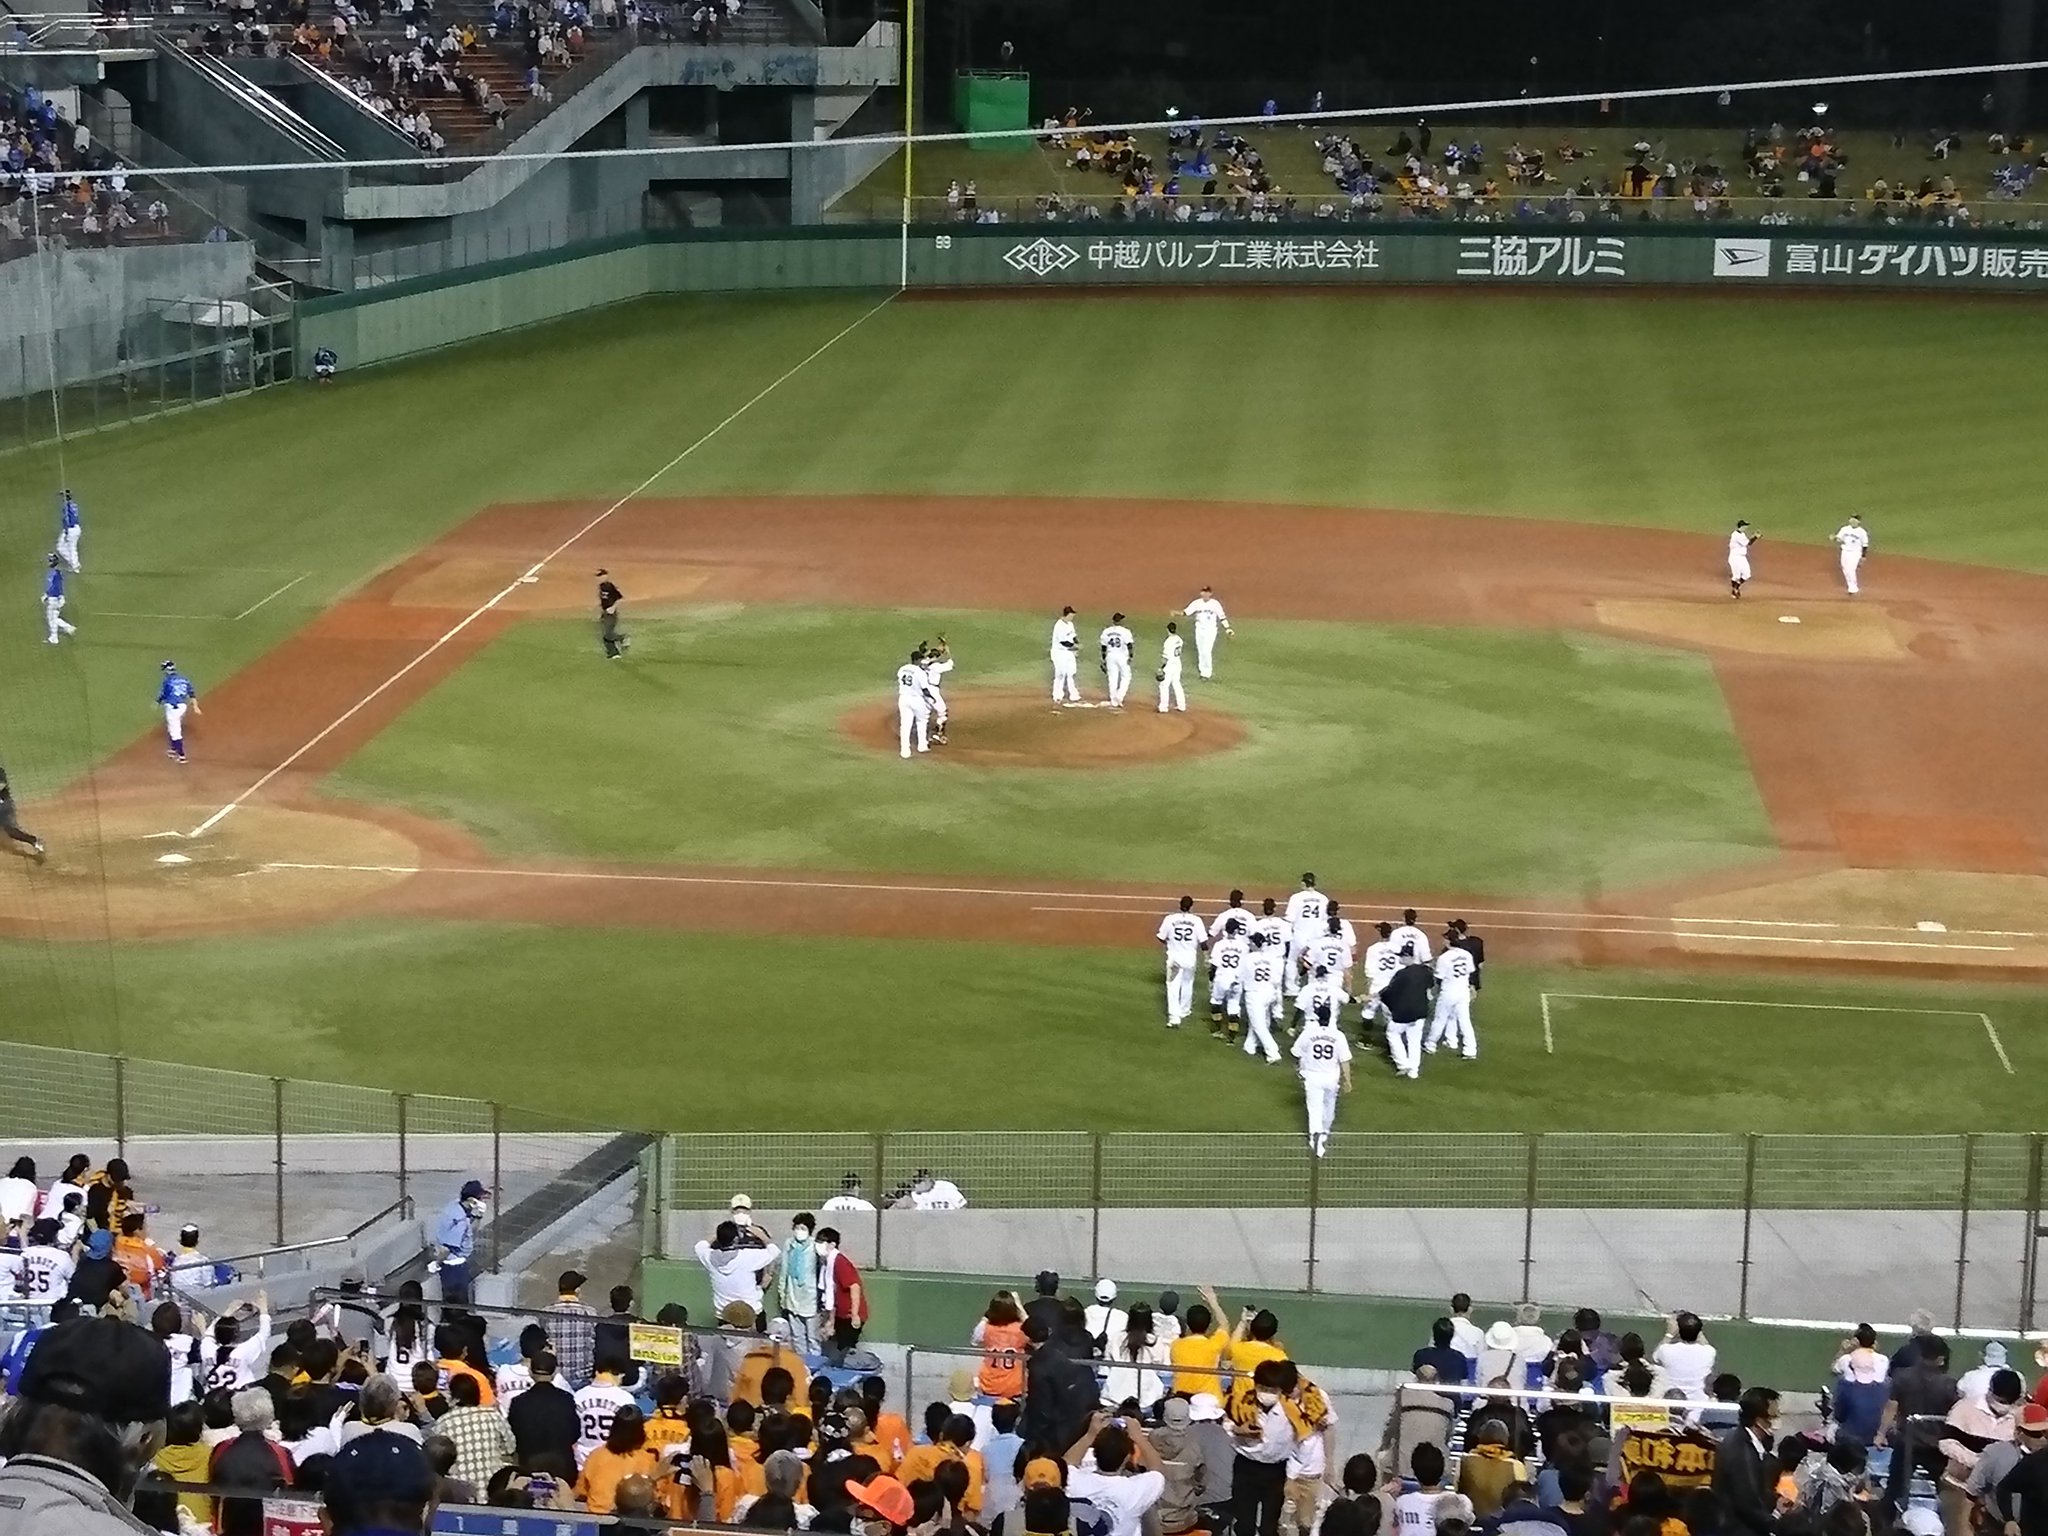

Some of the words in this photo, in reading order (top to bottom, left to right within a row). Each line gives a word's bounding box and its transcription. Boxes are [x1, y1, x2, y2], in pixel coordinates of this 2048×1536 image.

[1088, 240, 1379, 269] 中越パルプ工業株式会社
[1456, 235, 1626, 276] 三協アルミ
[1786, 243, 2048, 279] 富山ダイハツ販売
[1302, 904, 1319, 918] 24
[1174, 927, 1193, 941] 52
[1327, 952, 1337, 966] 5
[1312, 1044, 1334, 1060] 99
[583, 1414, 615, 1441] 25
